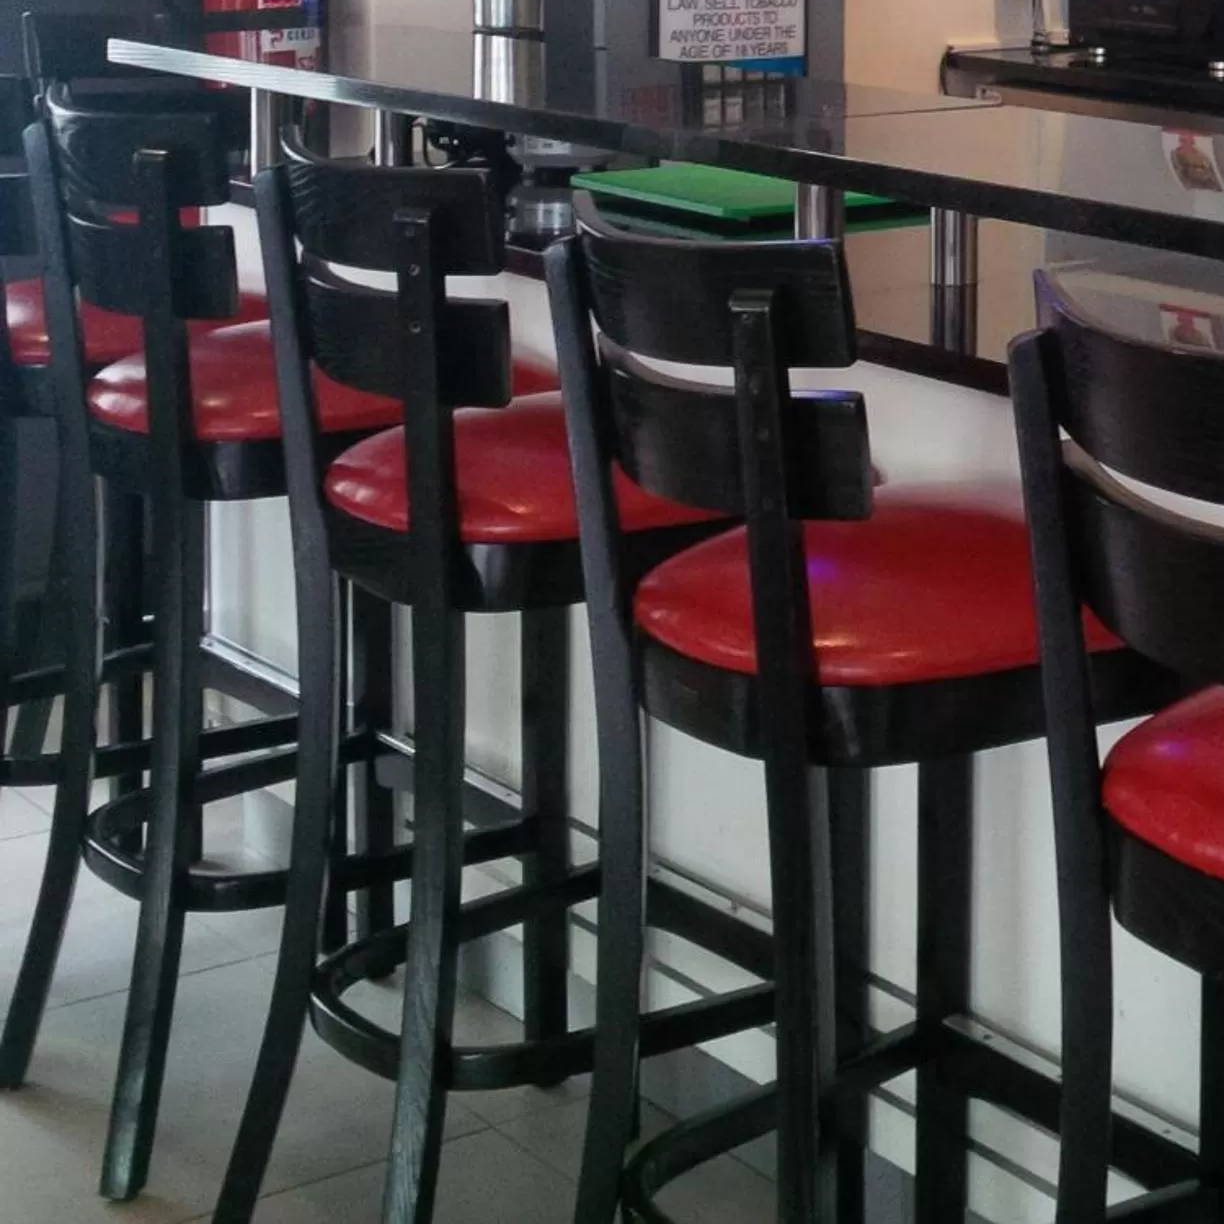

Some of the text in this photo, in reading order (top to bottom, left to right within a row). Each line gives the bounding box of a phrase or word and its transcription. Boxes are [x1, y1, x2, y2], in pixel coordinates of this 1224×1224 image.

[693, 10, 778, 26] PRODUCTS TO
[669, 24, 797, 43] ANYONE UNDER THE
[680, 45, 708, 59] AGE
[712, 44, 732, 58] OF
[750, 42, 789, 57] YEARS
